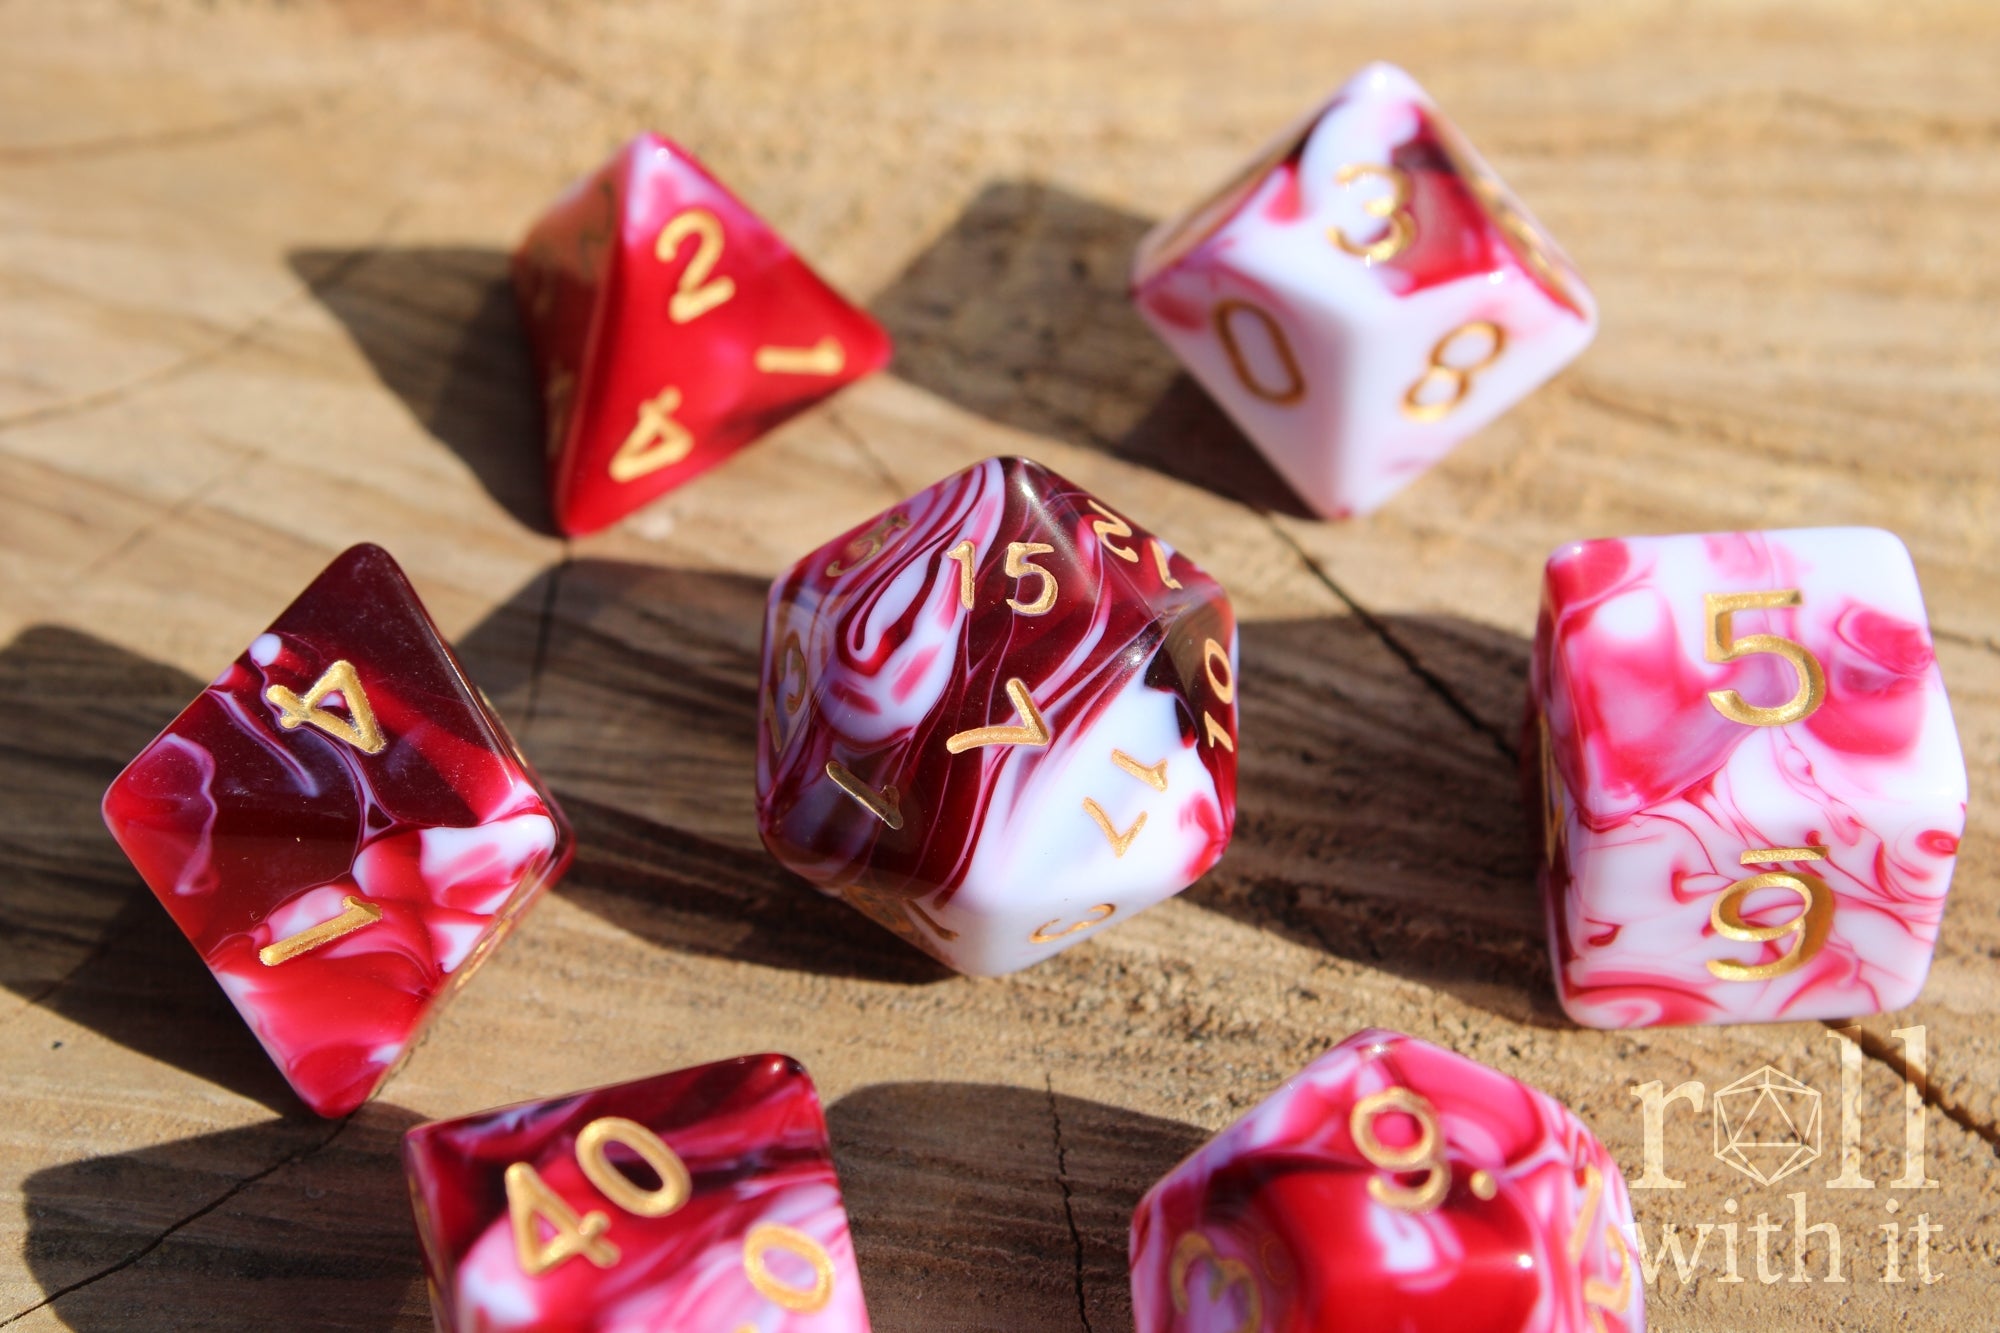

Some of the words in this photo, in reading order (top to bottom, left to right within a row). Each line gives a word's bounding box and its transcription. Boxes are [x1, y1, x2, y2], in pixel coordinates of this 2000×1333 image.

[1326, 163, 1417, 264] 3
[655, 207, 736, 324] 2
[754, 335, 846, 377] 1
[1212, 299, 1307, 407] 0
[1399, 321, 1509, 424] 8
[608, 384, 695, 482] 4
[945, 540, 1059, 617] 15
[1087, 498, 1183, 591] 12
[1203, 637, 1236, 754] 10
[1703, 588, 1827, 727] 5
[265, 659, 387, 755] 4
[945, 678, 1051, 756] 7
[825, 760, 904, 831] 1
[1082, 748, 1168, 859] 17
[258, 895, 383, 967] 1
[1029, 903, 1117, 943] 3
[504, 1116, 693, 1278] 40
